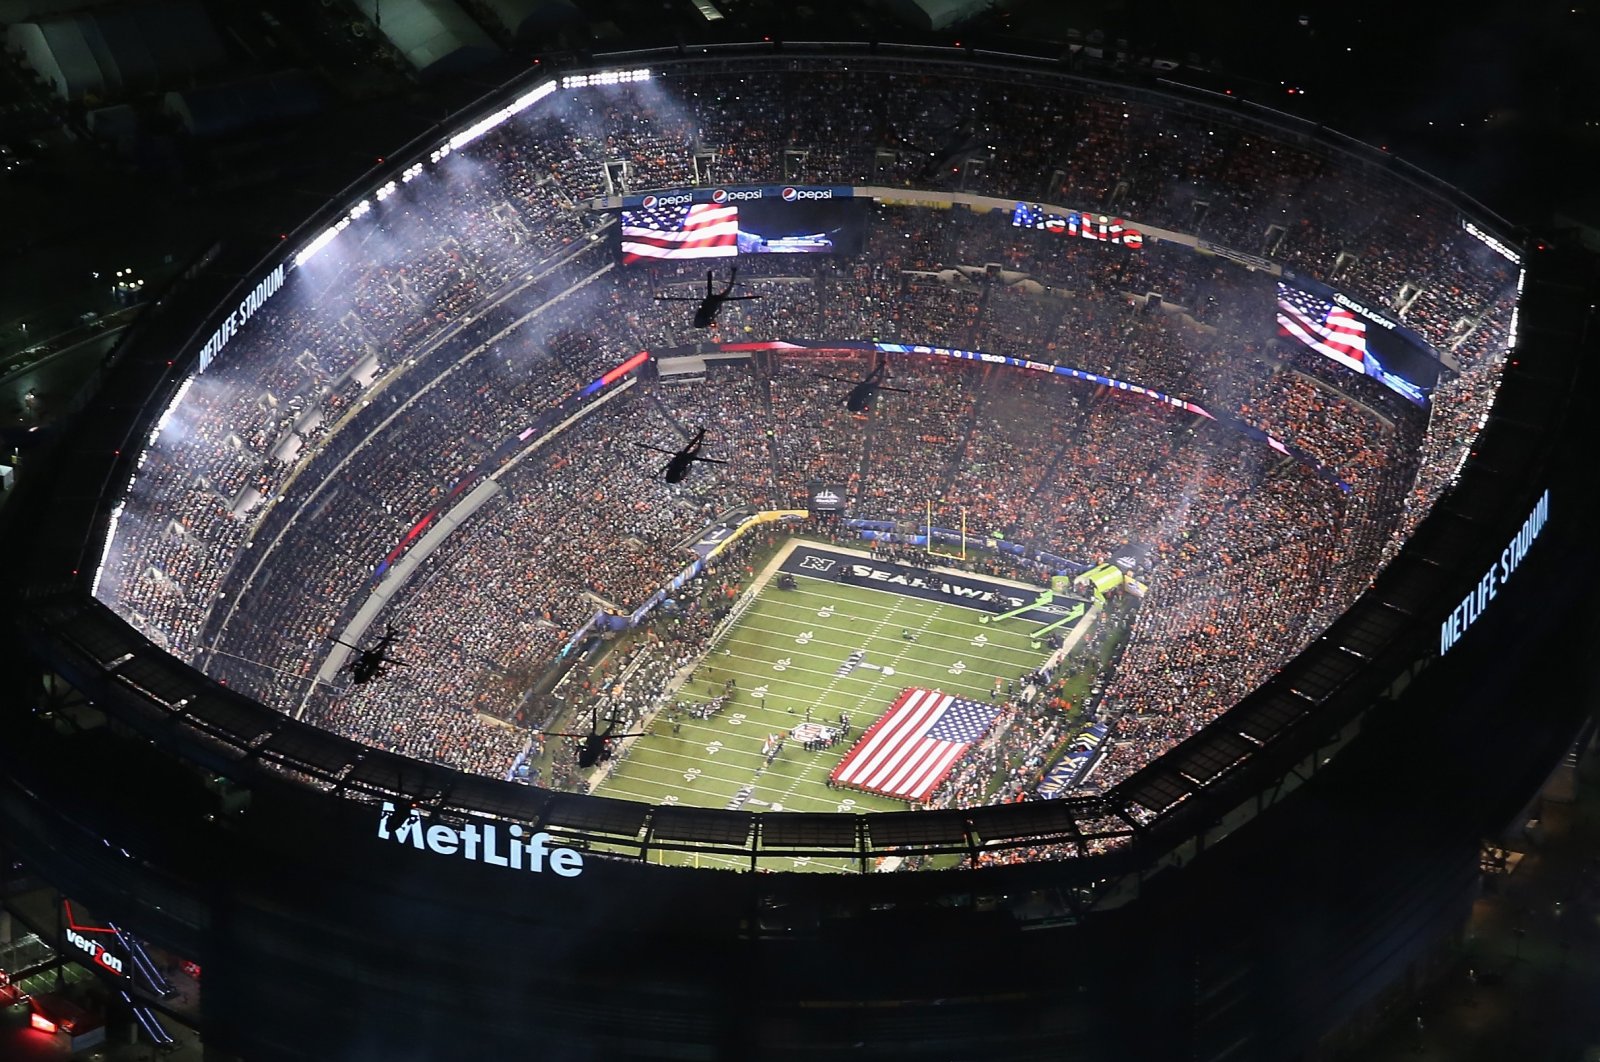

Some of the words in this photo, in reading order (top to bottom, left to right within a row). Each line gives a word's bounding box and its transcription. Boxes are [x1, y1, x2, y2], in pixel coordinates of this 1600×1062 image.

[658, 192, 692, 207] pepsi
[728, 189, 762, 201] pepsi
[797, 189, 832, 200] pepsi
[1012, 202, 1143, 249] MetLife
[199, 310, 238, 374] METLIFE
[239, 264, 284, 326] STADIUM
[1338, 293, 1363, 313] BUD
[1361, 308, 1397, 330] LIGHT
[1440, 562, 1498, 657] METLIFE
[1500, 488, 1549, 584] STADIUM
[378, 801, 584, 878] MetLife
[66, 928, 122, 976] verizon
